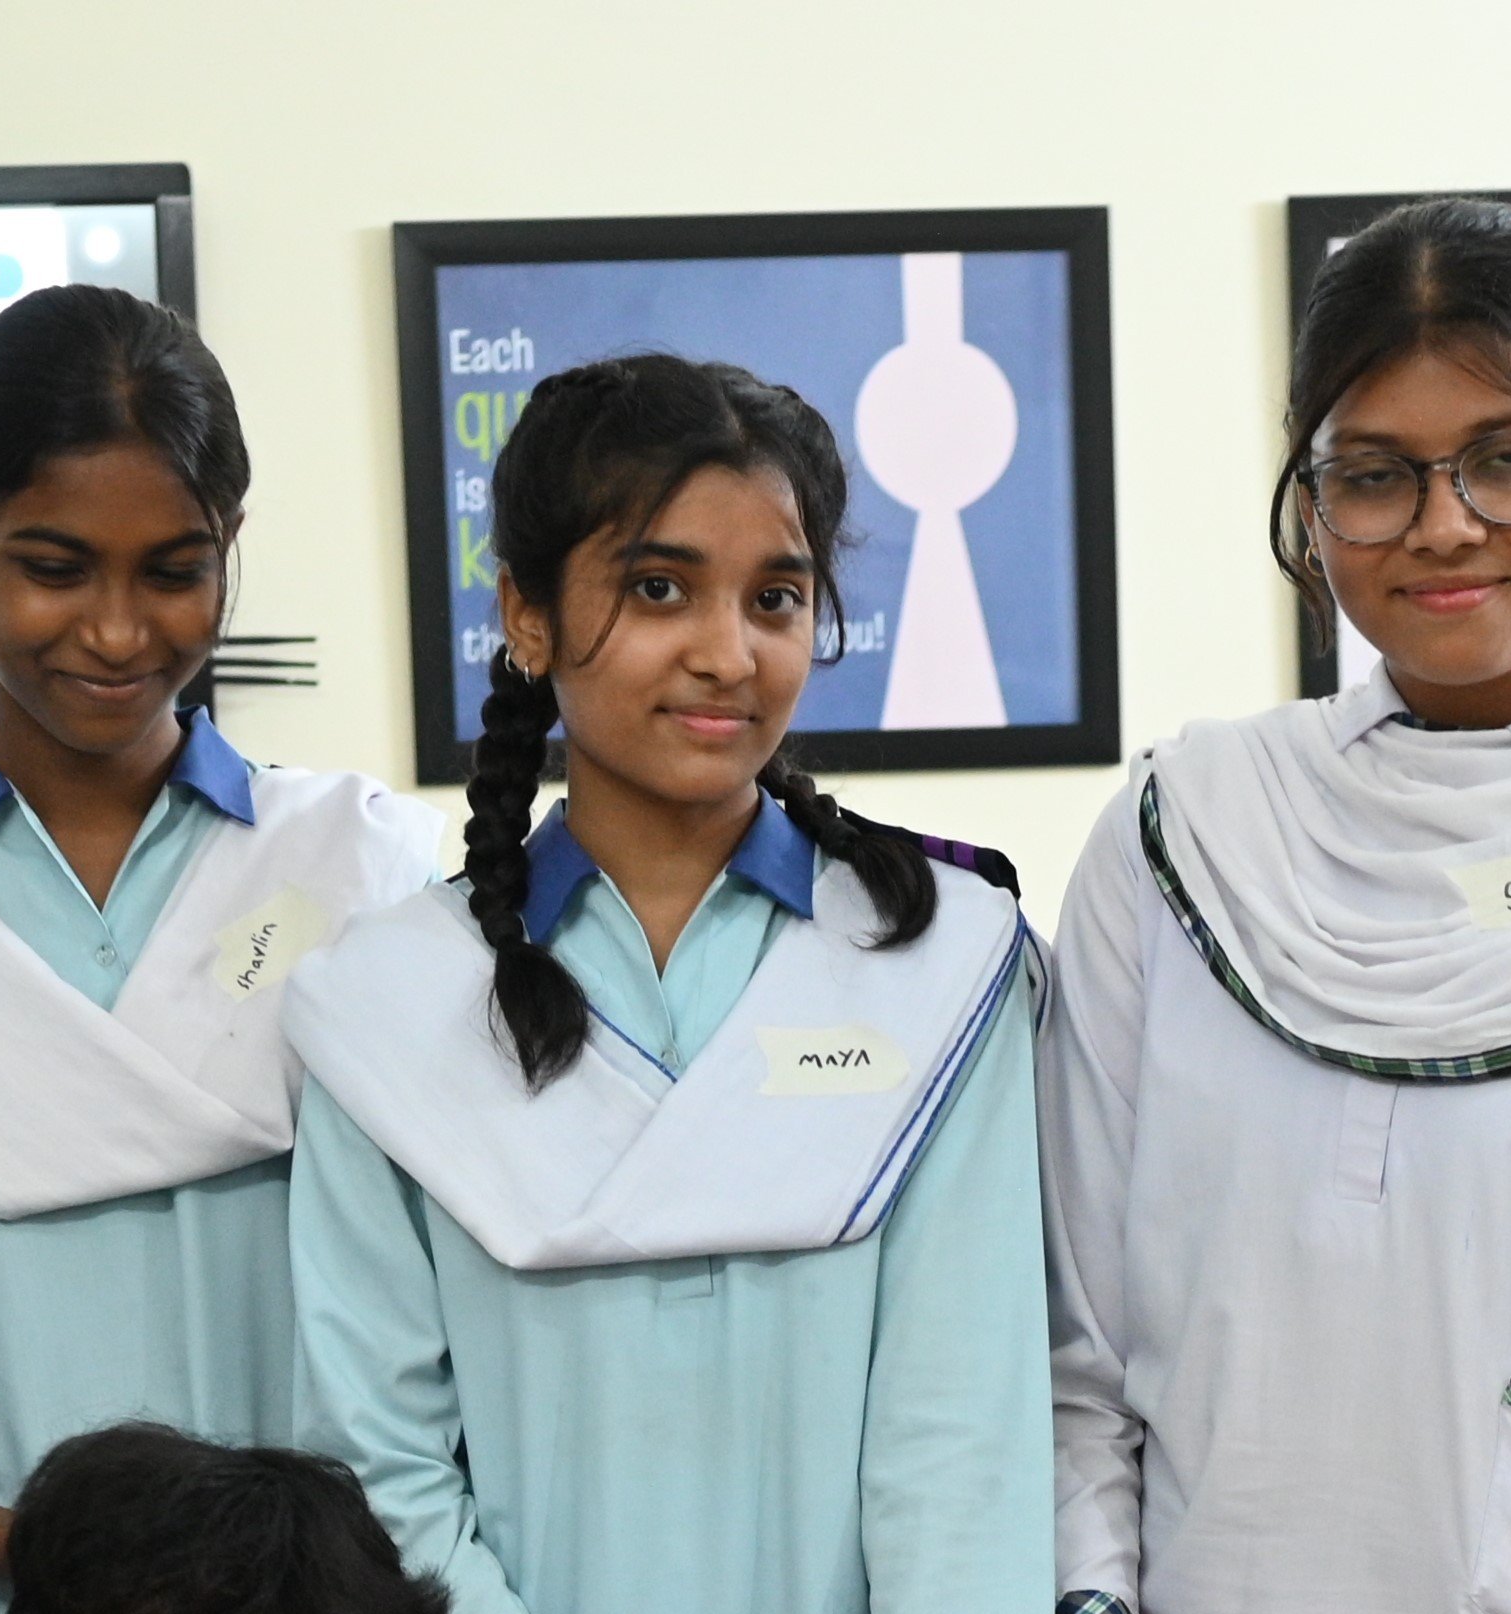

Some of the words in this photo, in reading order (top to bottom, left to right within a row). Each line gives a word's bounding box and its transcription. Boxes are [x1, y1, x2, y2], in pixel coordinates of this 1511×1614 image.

[448, 326, 535, 374] Each
[456, 390, 530, 463] qu
[454, 469, 487, 513] is
